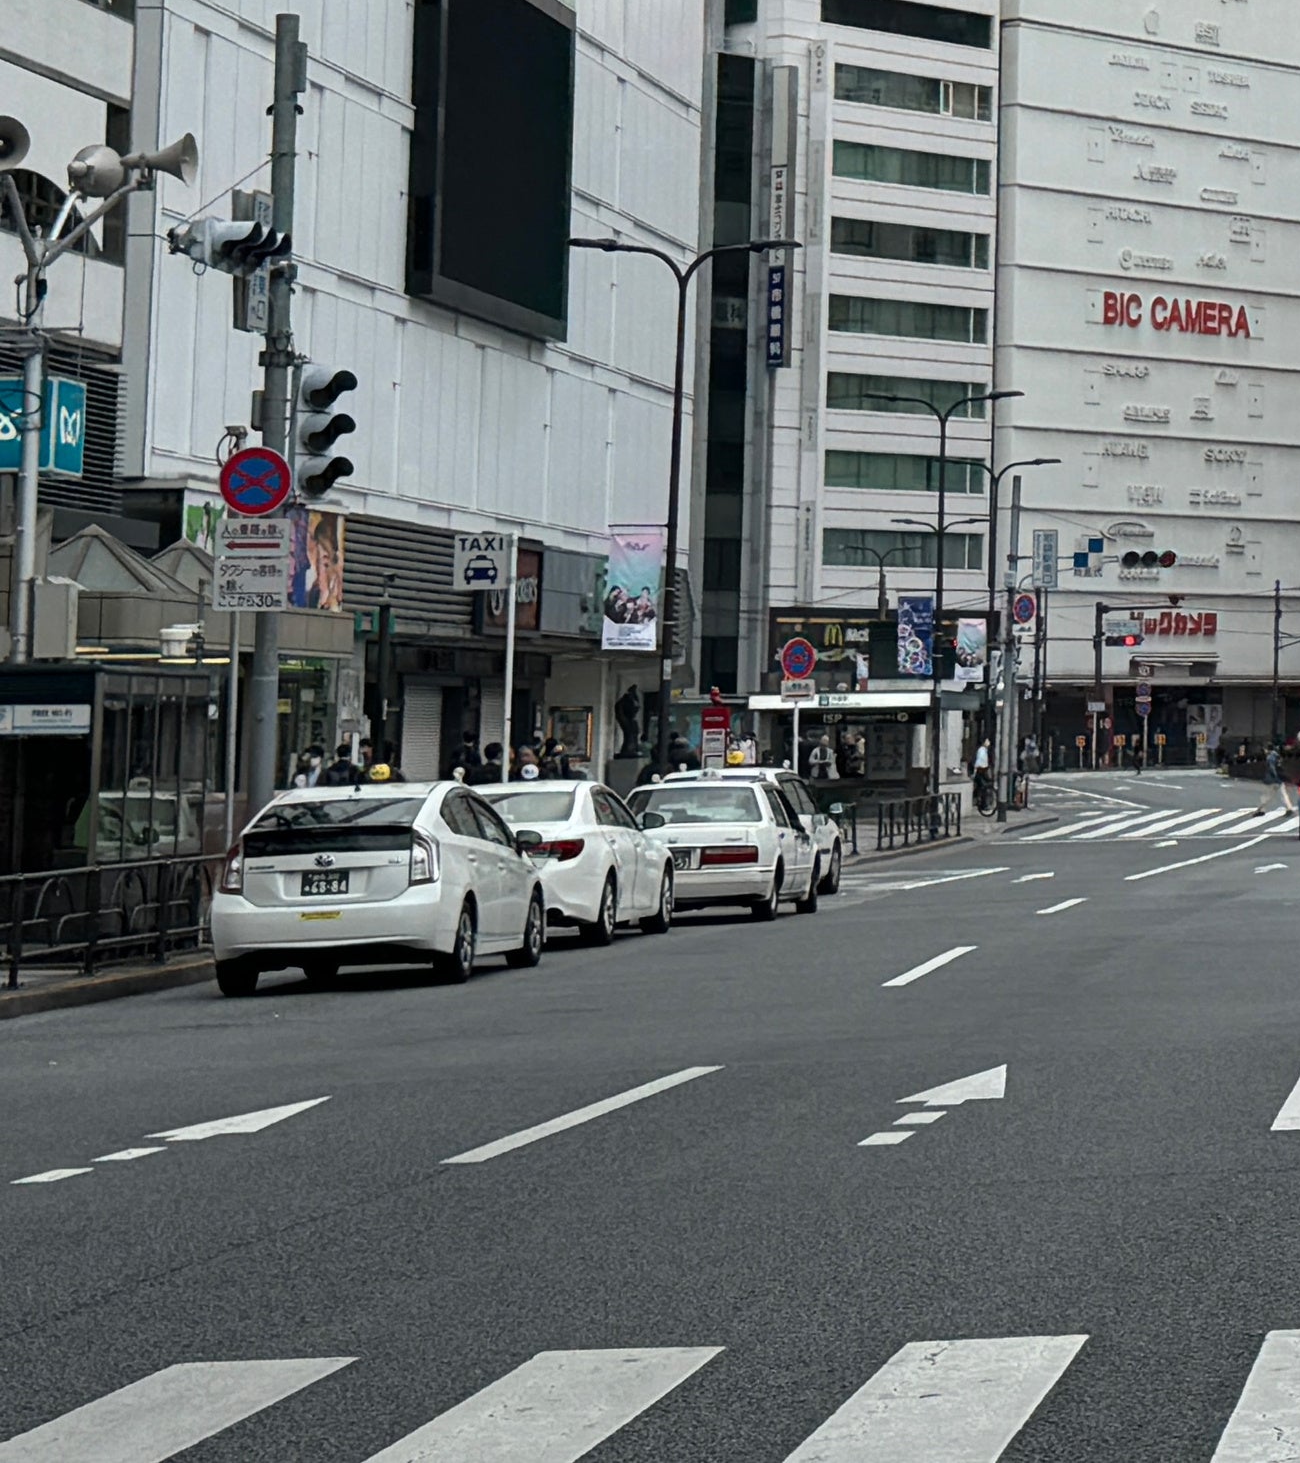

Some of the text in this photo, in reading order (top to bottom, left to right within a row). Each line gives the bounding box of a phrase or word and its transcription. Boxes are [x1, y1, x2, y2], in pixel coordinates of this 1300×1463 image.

[1102, 291, 1251, 340] BIC CAMERA
[459, 538, 504, 552] TAXI
